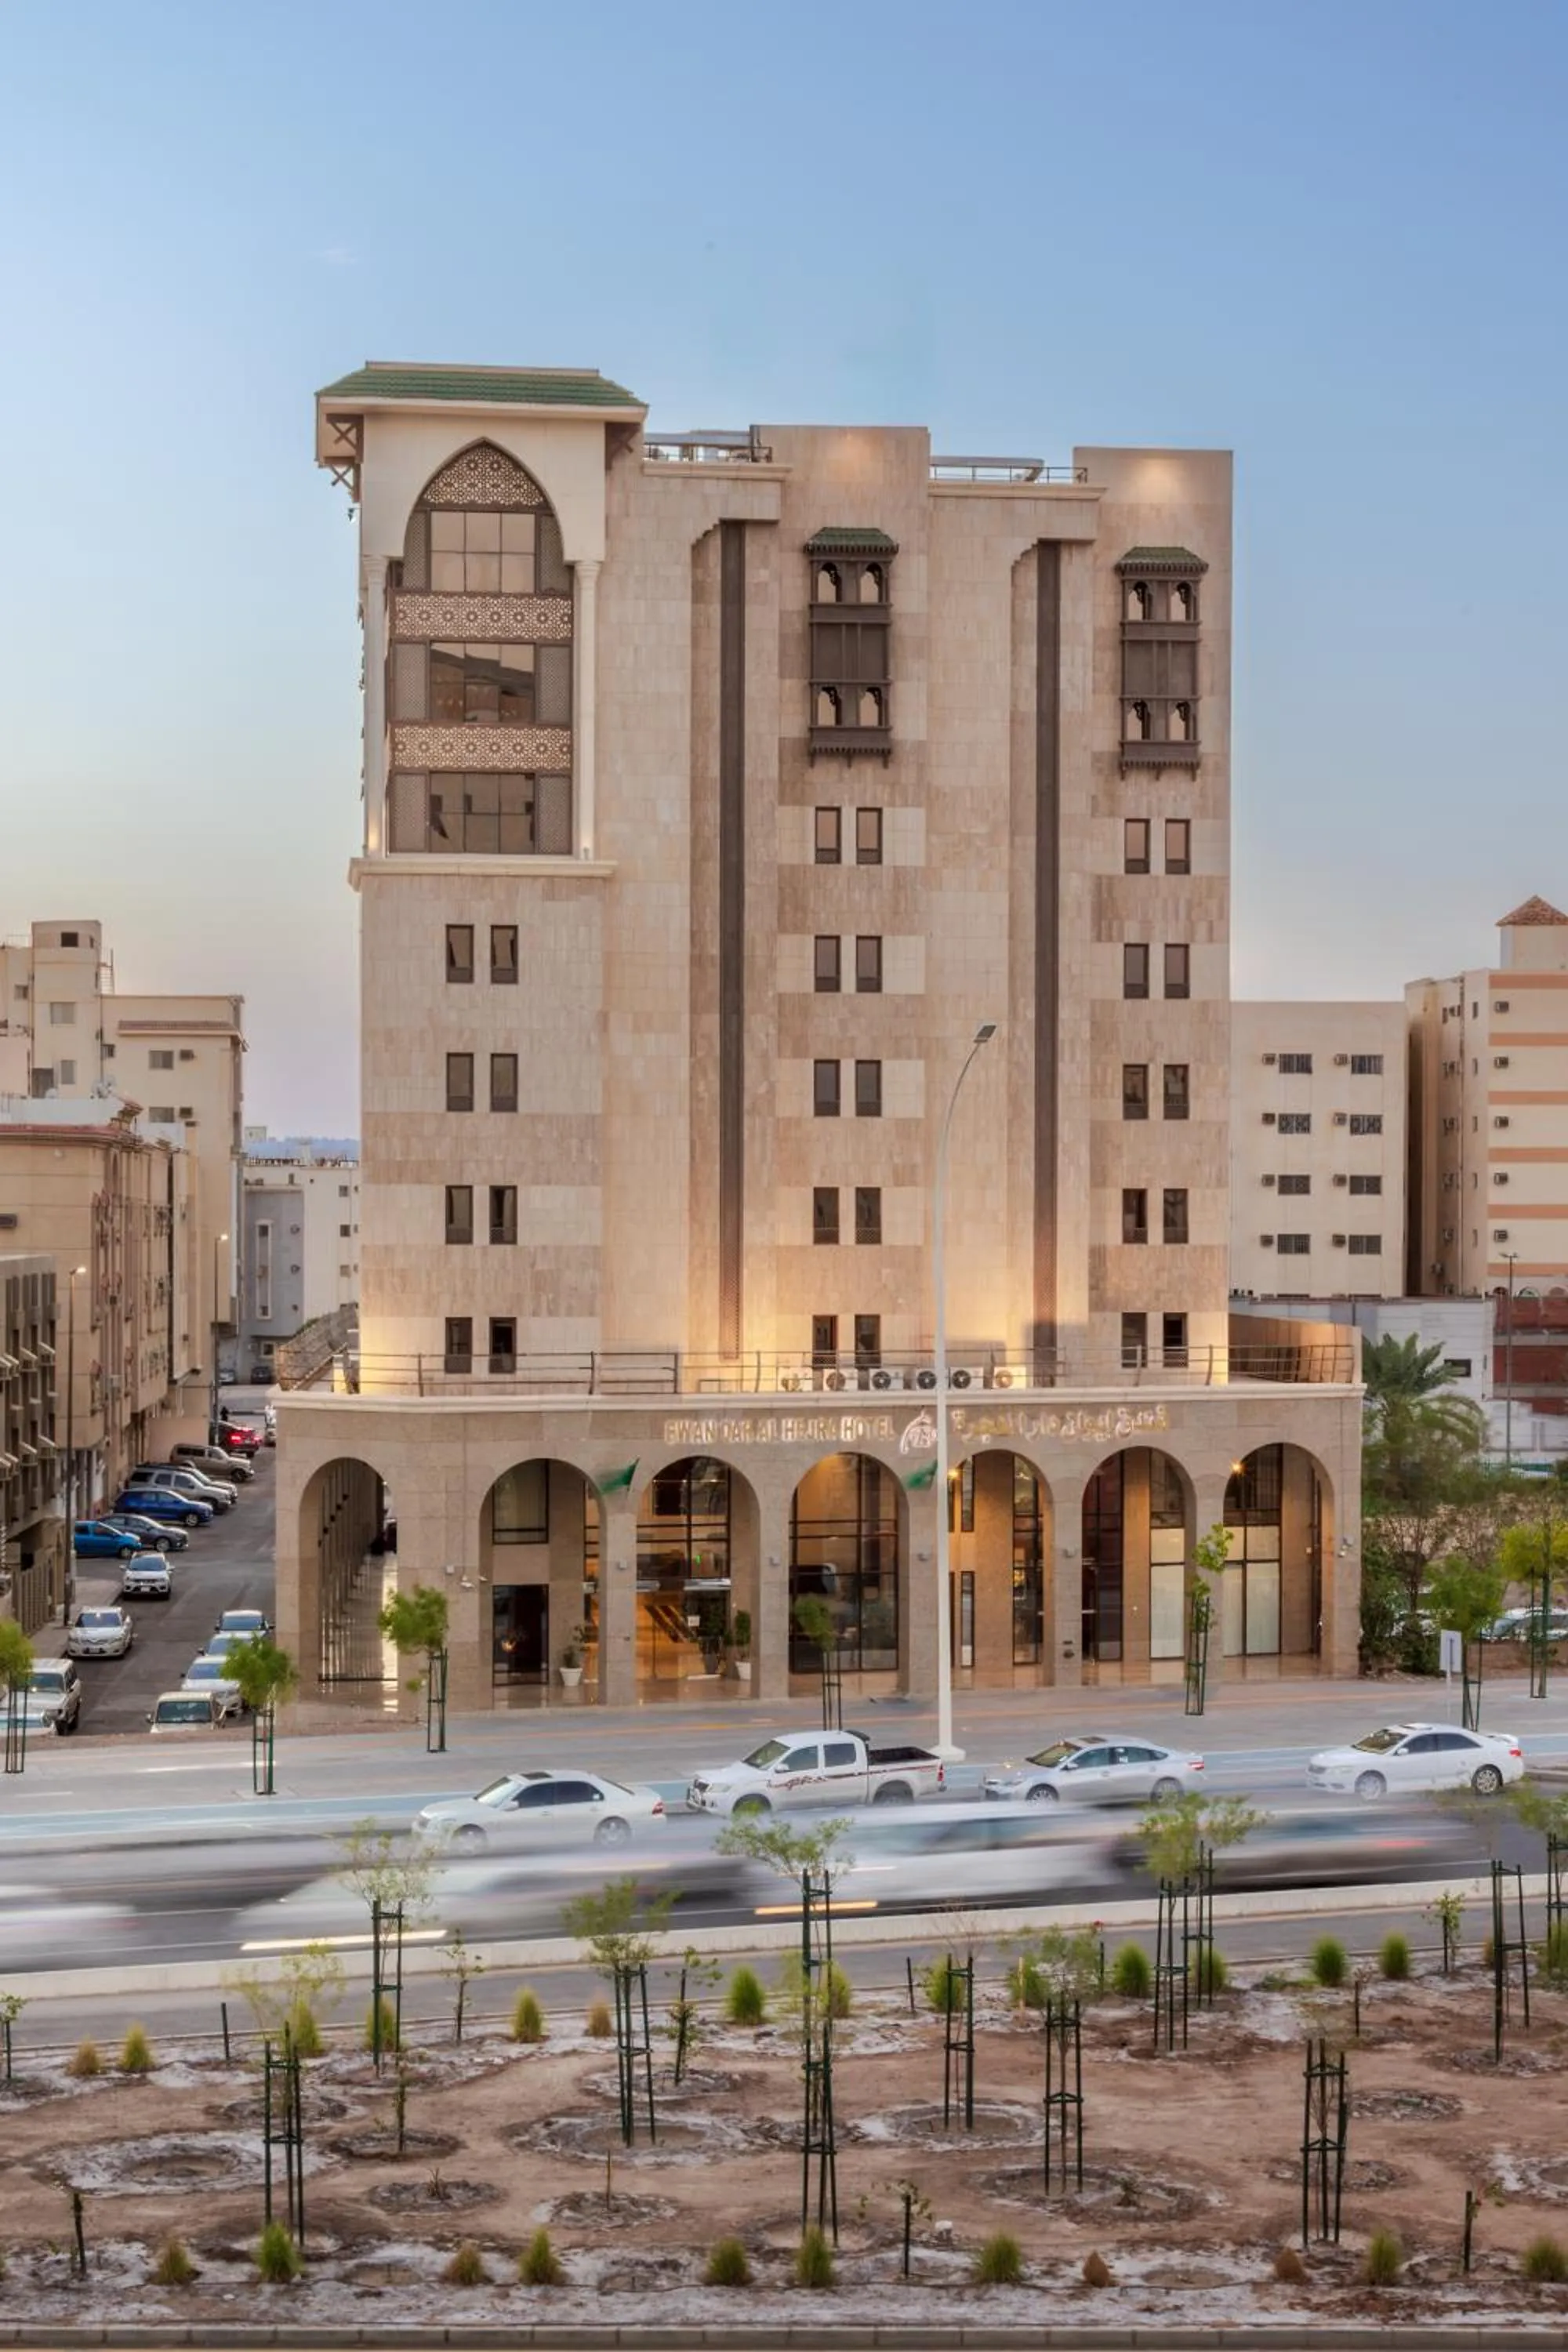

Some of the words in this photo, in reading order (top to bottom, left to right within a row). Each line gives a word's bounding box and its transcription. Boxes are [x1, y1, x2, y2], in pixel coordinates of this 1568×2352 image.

[665, 1419, 717, 1444] EWAN
[720, 1418, 754, 1443] DAR
[756, 1418, 779, 1443] AL
[782, 1417, 837, 1441] HEJRA
[841, 1415, 896, 1441] HOTEL
